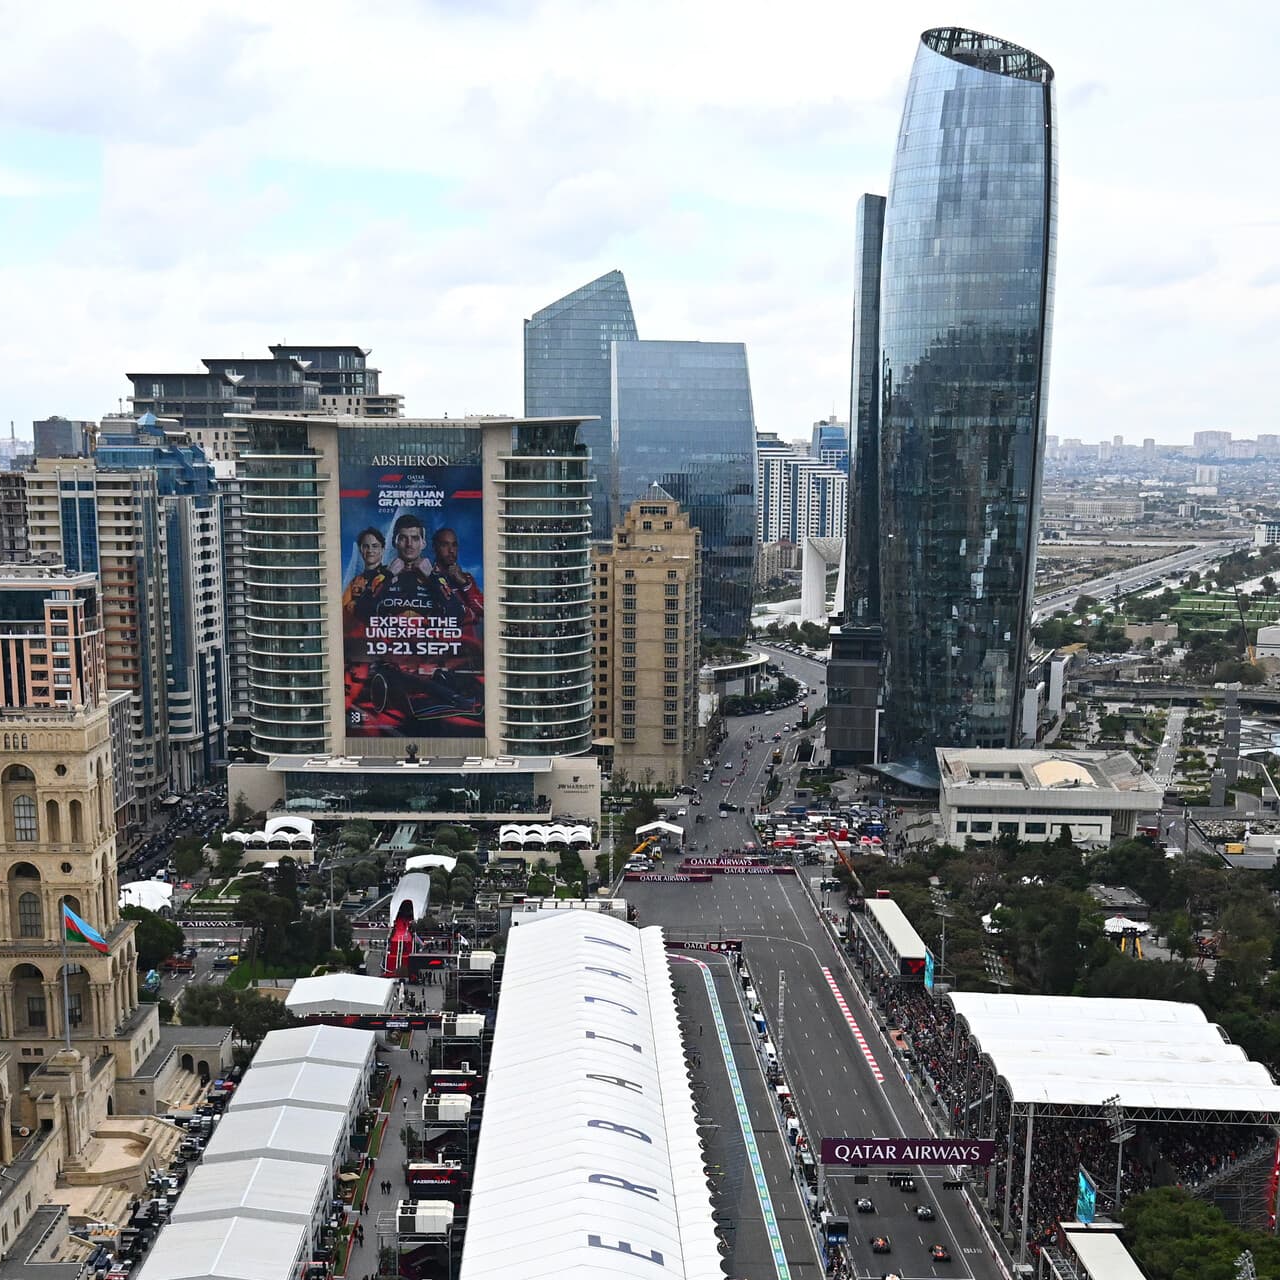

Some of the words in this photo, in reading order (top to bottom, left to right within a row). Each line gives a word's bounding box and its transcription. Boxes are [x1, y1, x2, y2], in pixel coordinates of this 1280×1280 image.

[371, 455, 449, 467] ABSHERON
[378, 490, 444, 499] AZERBAIJAN
[378, 499, 415, 507] GRAND
[419, 499, 442, 507] PRIX
[383, 598, 433, 608] ORACLE
[369, 616, 424, 628] EXPECT
[427, 616, 457, 628] THE
[365, 628, 462, 639] UNEXPECTED
[366, 642, 413, 655] 19-21
[416, 642, 462, 655] SEPT
[690, 858, 718, 866] QATAR
[719, 857, 753, 866] AIRWAYS
[747, 867, 774, 875] AIRWAYS
[186, 920, 237, 928] AIRWAYS
[834, 1144, 897, 1162] QATAR
[901, 1145, 980, 1161] AIRWAYS
